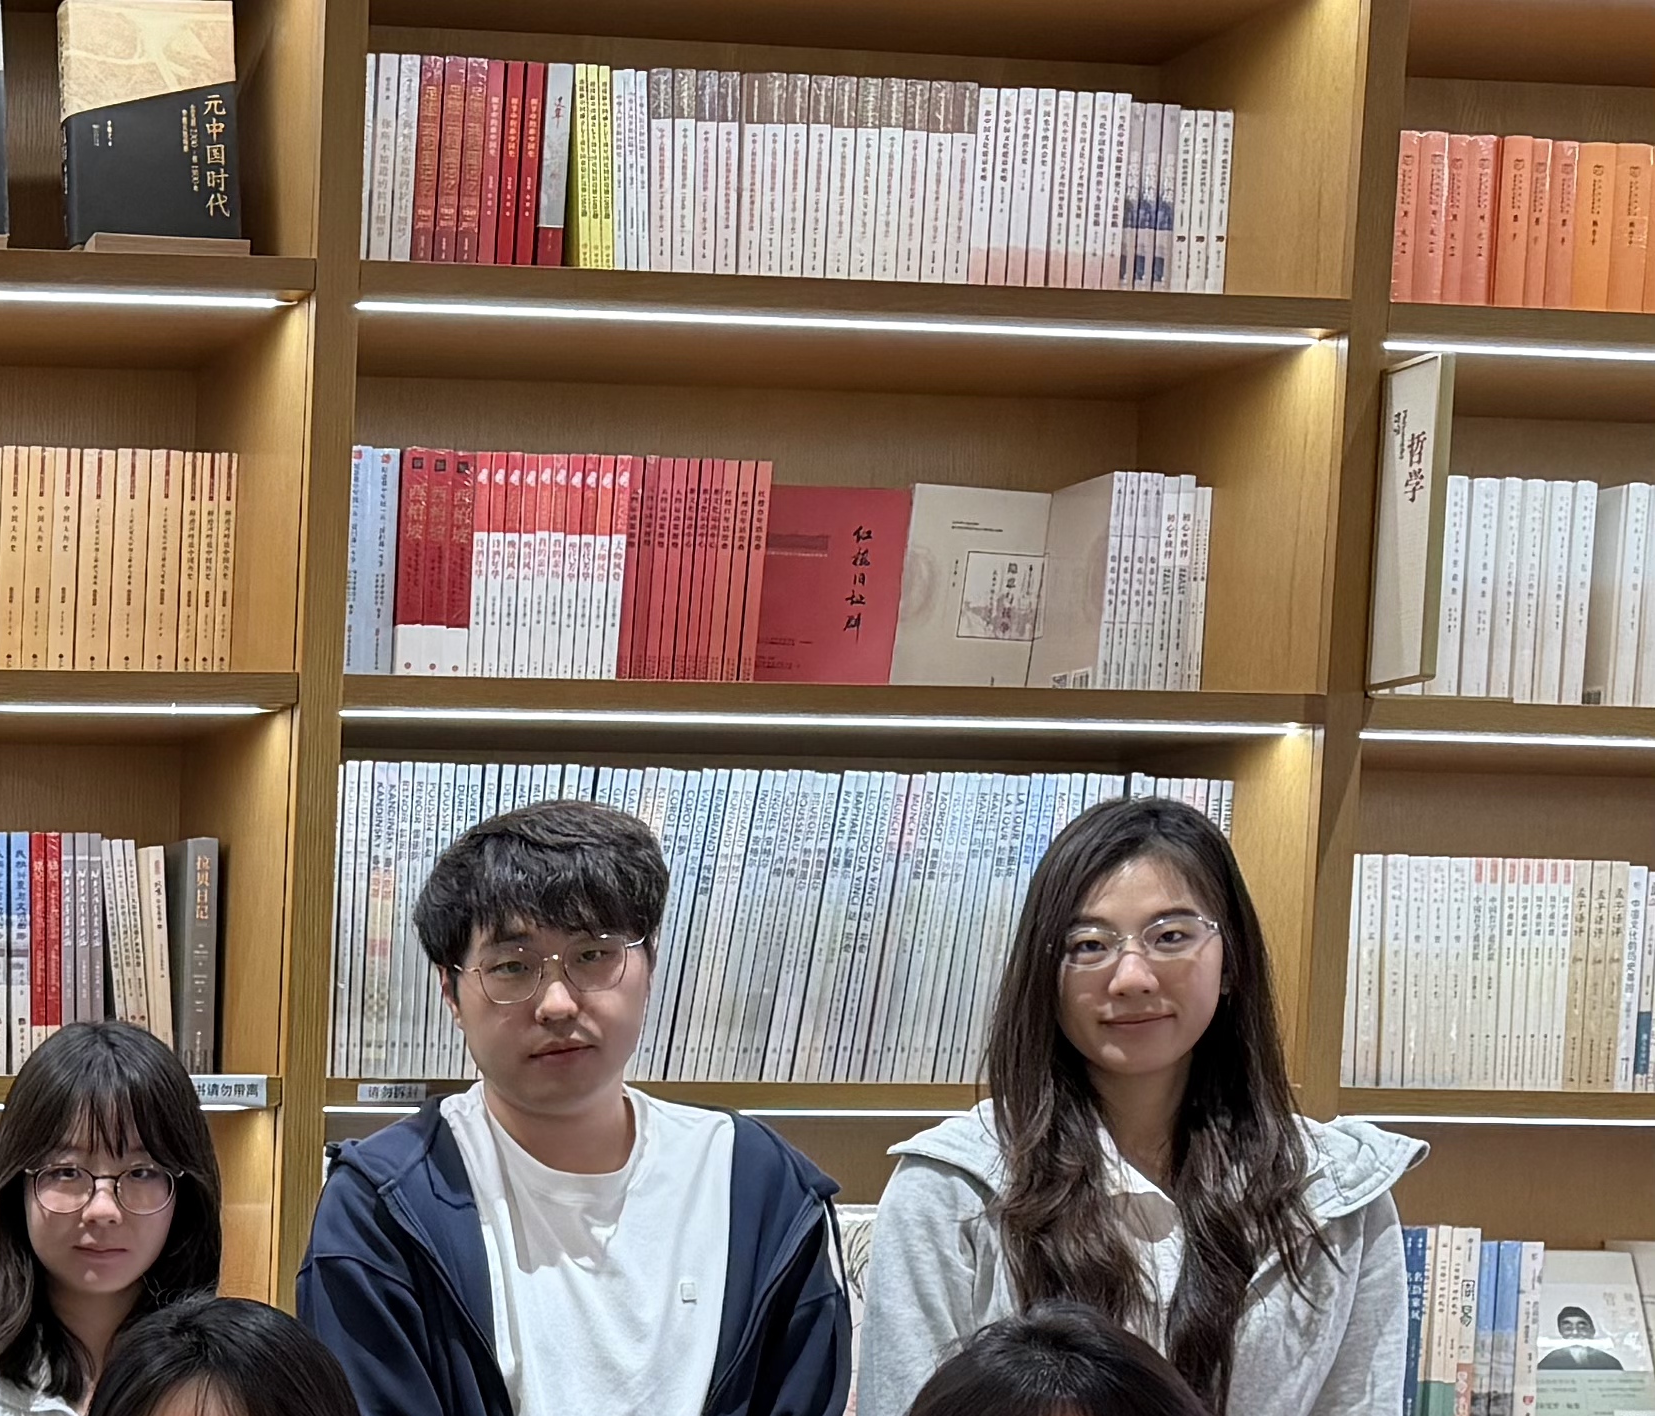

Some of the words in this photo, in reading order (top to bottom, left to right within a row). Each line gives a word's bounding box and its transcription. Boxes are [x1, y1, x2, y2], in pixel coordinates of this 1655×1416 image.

[203, 95, 230, 217] 元中国时代
[1404, 431, 1427, 502] 哲学
[373, 782, 386, 848] KANDINSKY
[413, 781, 423, 824] RENOIR
[441, 782, 451, 831] POUSSIN
[665, 790, 681, 828] COROT
[681, 790, 695, 829] COROT
[698, 789, 710, 813] VAN
[754, 789, 768, 830] INGRES
[767, 790, 782, 831] INGRES
[835, 790, 850, 841] RAPHAEL
[848, 791, 864, 841] RAPHAEL
[890, 793, 904, 836] MUNCH
[906, 794, 920, 836] MUNCH
[918, 791, 934, 841] MORISOT
[933, 791, 949, 842] MORISOT
[974, 792, 988, 832] MANET
[987, 793, 1000, 832] MANET
[1003, 793, 1013, 806] LA
[1016, 792, 1025, 806] LA
[692, 816, 706, 850] GOGH
[859, 790, 877, 853] LEONARDO
[874, 791, 891, 853] LEONARDO
[999, 809, 1011, 841] TOUR
[1011, 810, 1023, 840] TOUR
[856, 856, 866, 873] DA
[871, 857, 882, 873] DA
[195, 855, 210, 920] 拉贝日记
[851, 876, 864, 906] VINCI
[865, 877, 878, 906] VINCI
[368, 1085, 419, 1099] 请勿拆封
